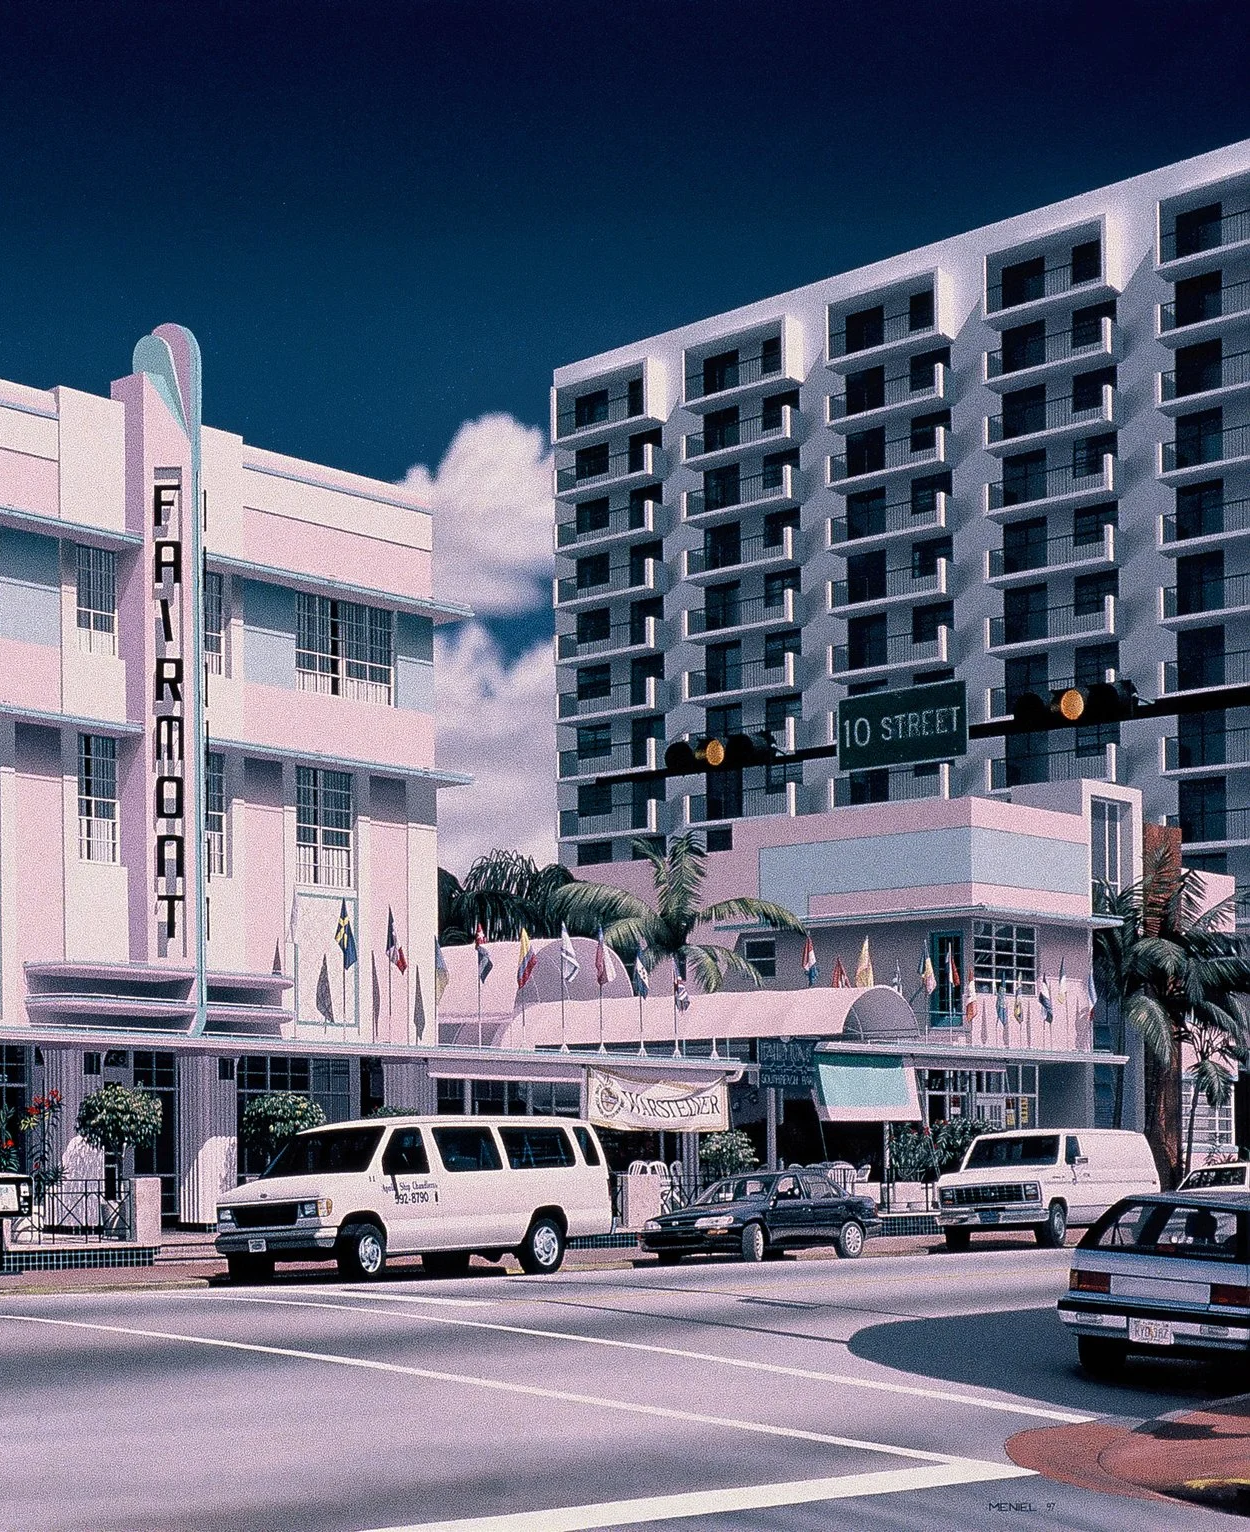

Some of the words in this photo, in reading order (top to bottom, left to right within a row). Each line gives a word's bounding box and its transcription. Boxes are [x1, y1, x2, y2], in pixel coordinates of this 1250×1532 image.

[153, 484, 184, 938] FAIRMONT
[843, 717, 870, 748] 10
[881, 706, 960, 740] STREET
[621, 1090, 721, 1118] WARSTEINER
[1045, 1502, 1056, 1512] 97
